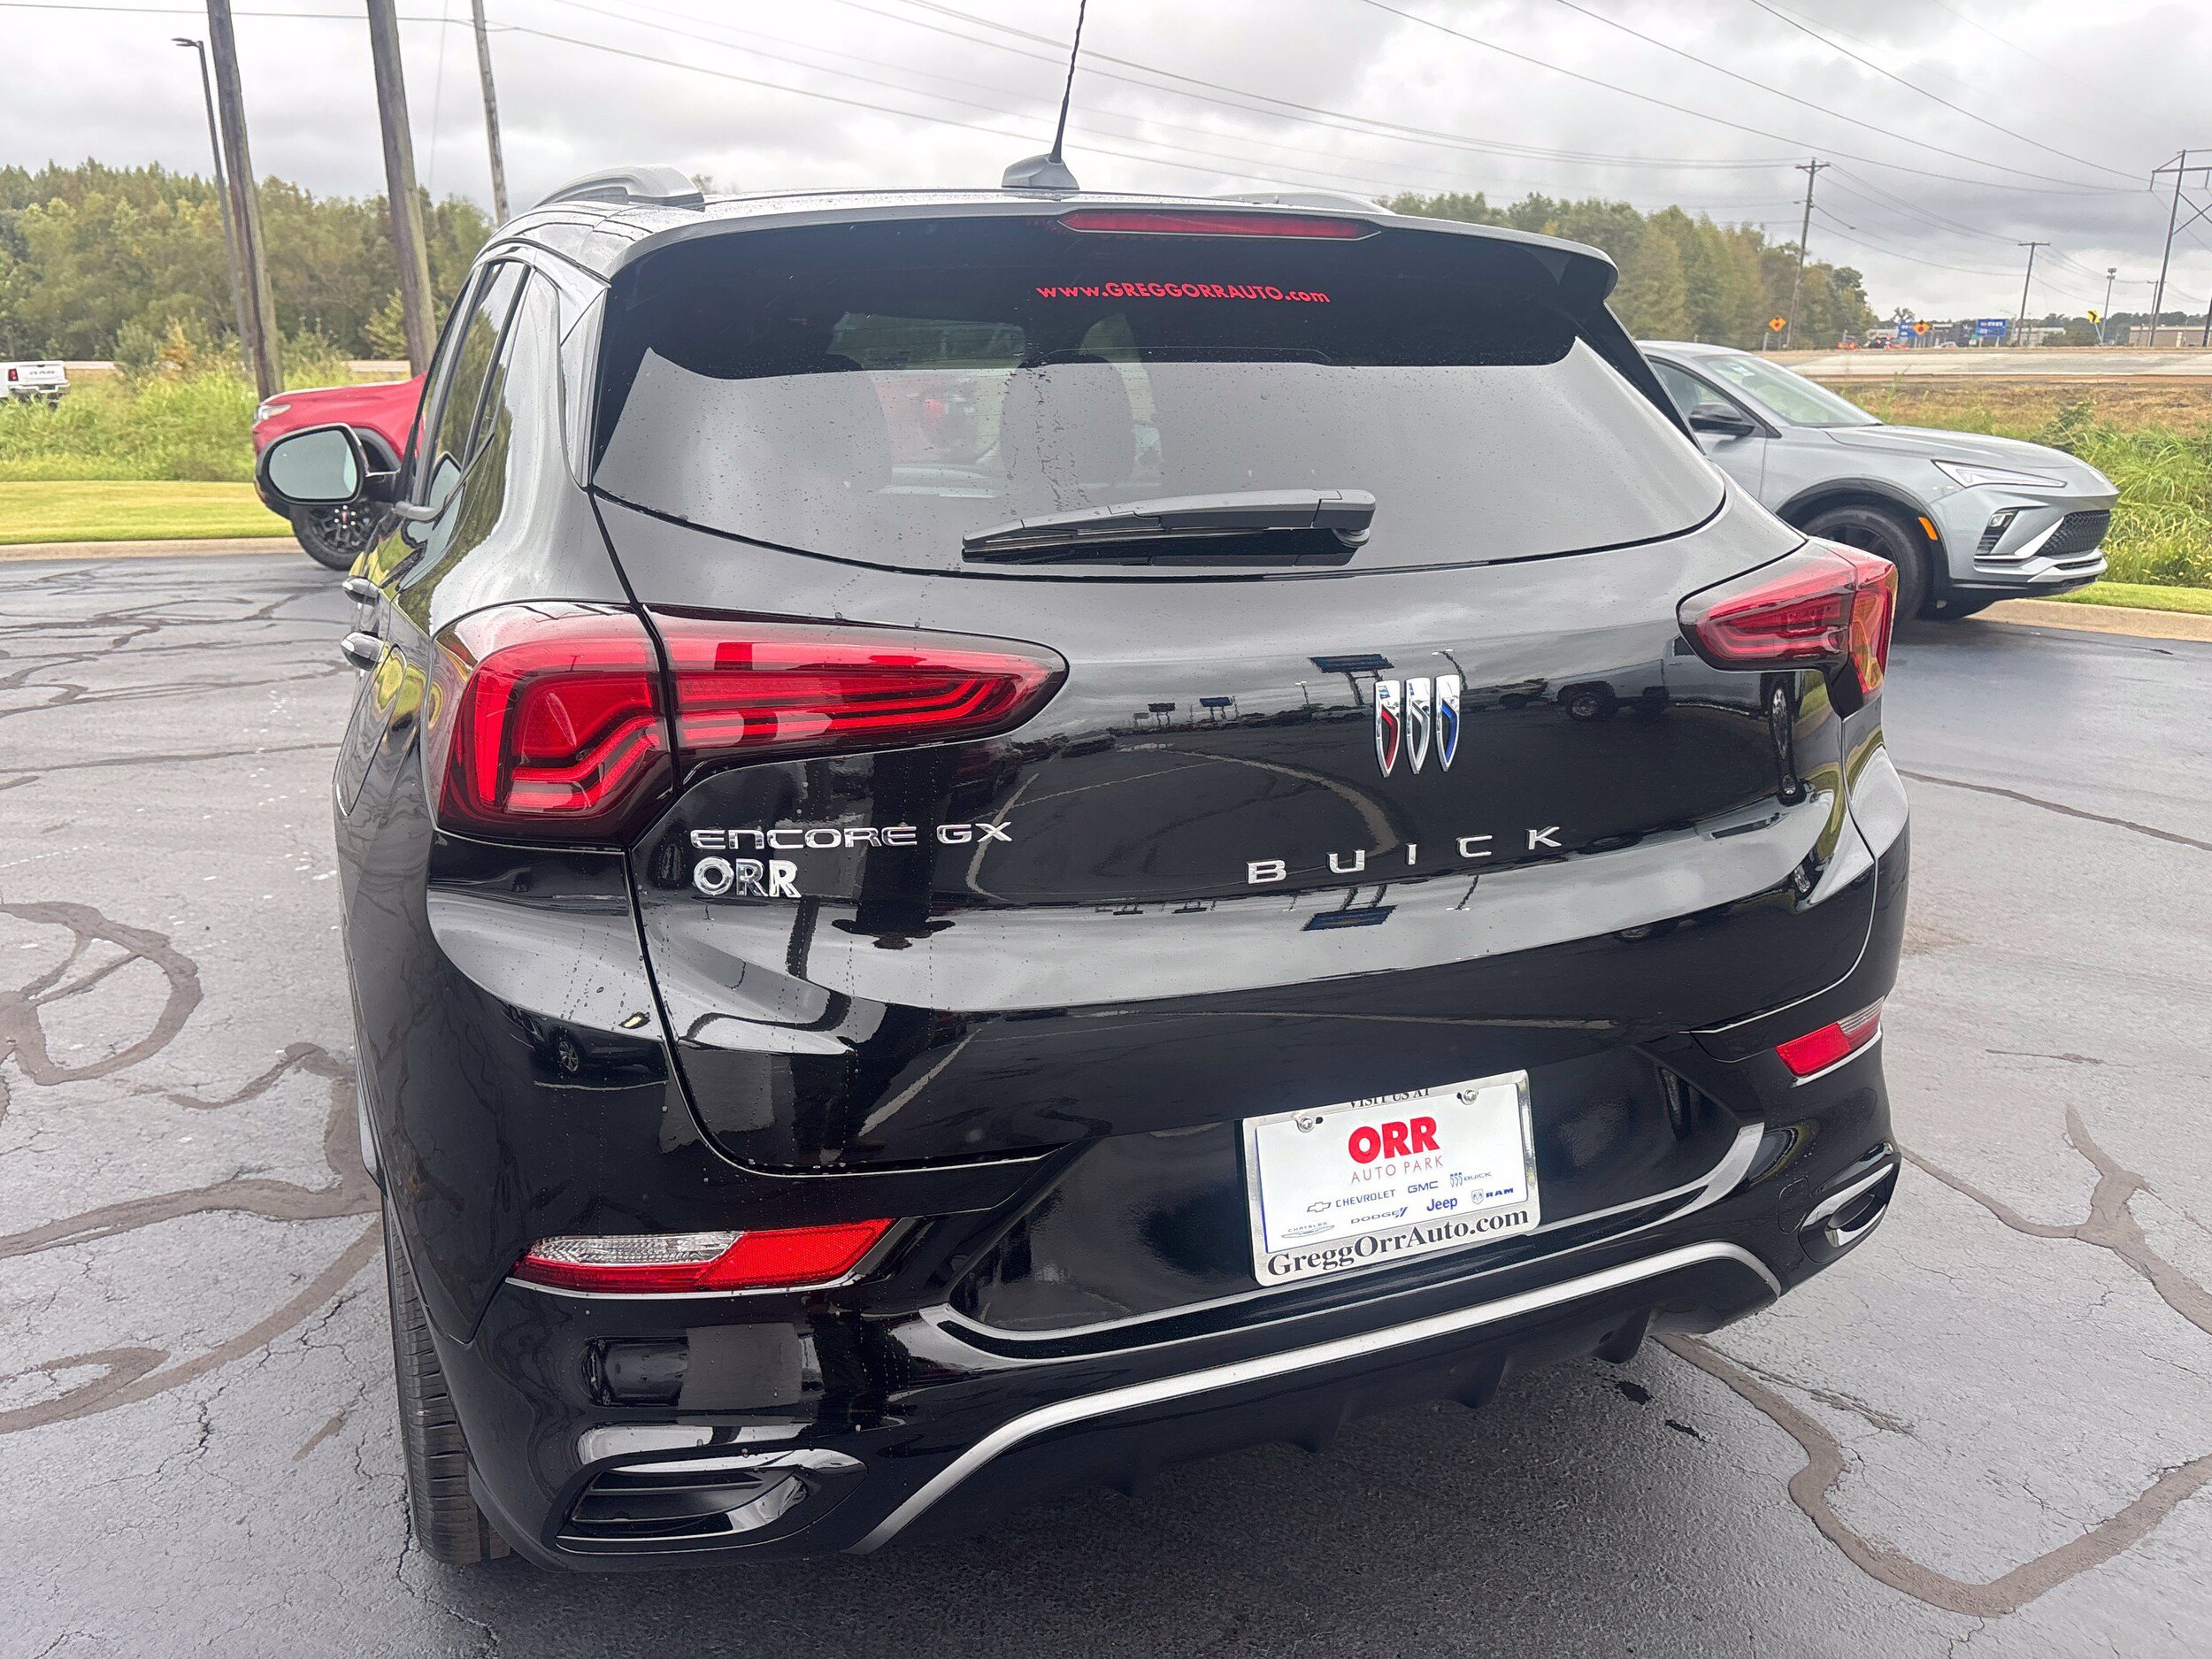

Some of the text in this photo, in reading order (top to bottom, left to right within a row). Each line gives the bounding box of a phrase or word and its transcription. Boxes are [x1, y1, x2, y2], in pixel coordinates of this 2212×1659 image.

[1036, 282, 1331, 303] www.GREGGORRAUTO.com
[690, 821, 1012, 849] ENCORE GX
[1246, 826, 1563, 884] BUICK
[693, 856, 802, 898] ORR
[1348, 1116, 1441, 1164] ORR
[1351, 1155, 1444, 1184] AUTO PARK
[1463, 1171, 1492, 1181] BUICK
[1407, 1180, 1440, 1194] GMC
[1486, 1187, 1514, 1198] RAM
[1335, 1189, 1396, 1208] CHEVROLET
[1426, 1196, 1458, 1212] Jeep
[1287, 1221, 1328, 1233] CHRYSLER
[1350, 1210, 1400, 1225] DODGE
[1267, 1210, 1529, 1277] GreggOrrAuto.com
